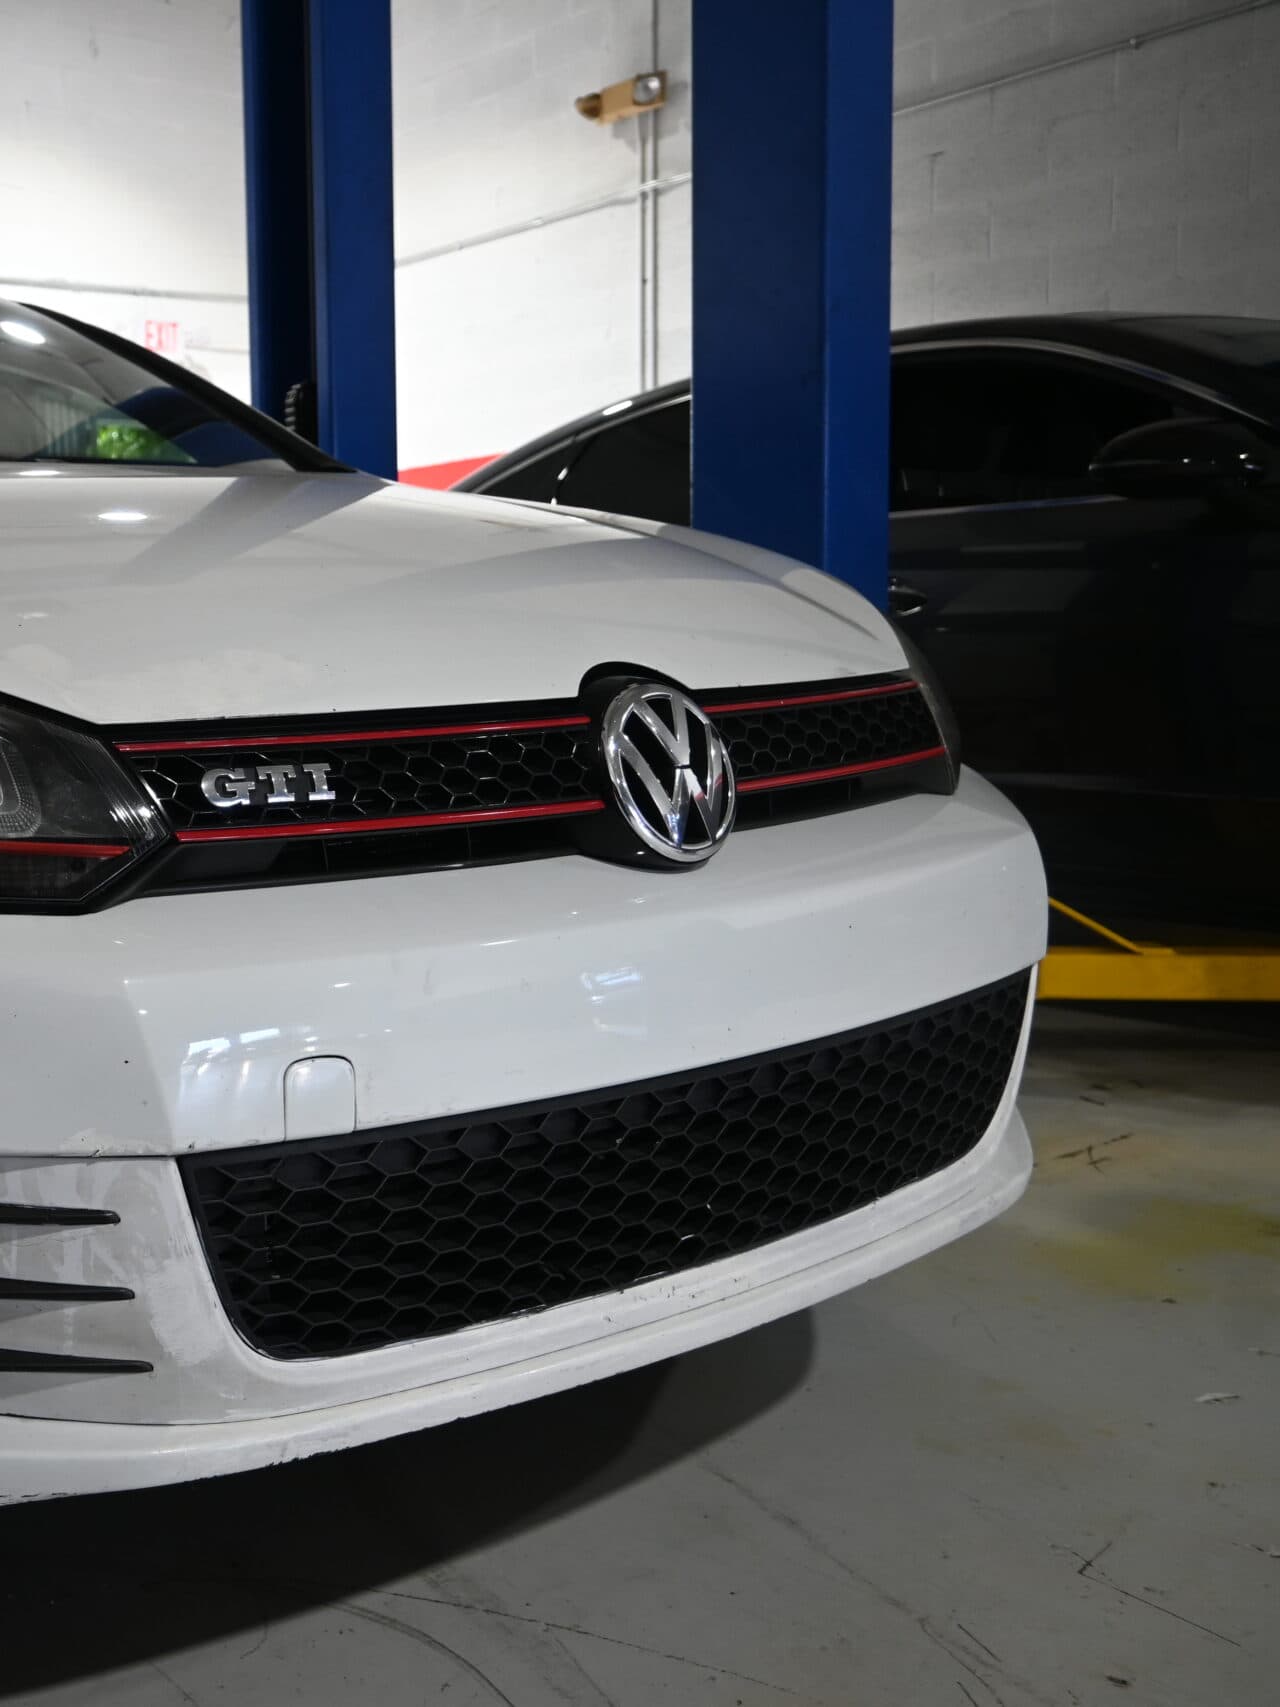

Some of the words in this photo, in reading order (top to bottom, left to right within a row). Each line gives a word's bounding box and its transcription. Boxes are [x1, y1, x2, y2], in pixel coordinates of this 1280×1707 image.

[144, 320, 180, 352] EXIT
[200, 762, 337, 808] GTI
[611, 690, 729, 855] VW
